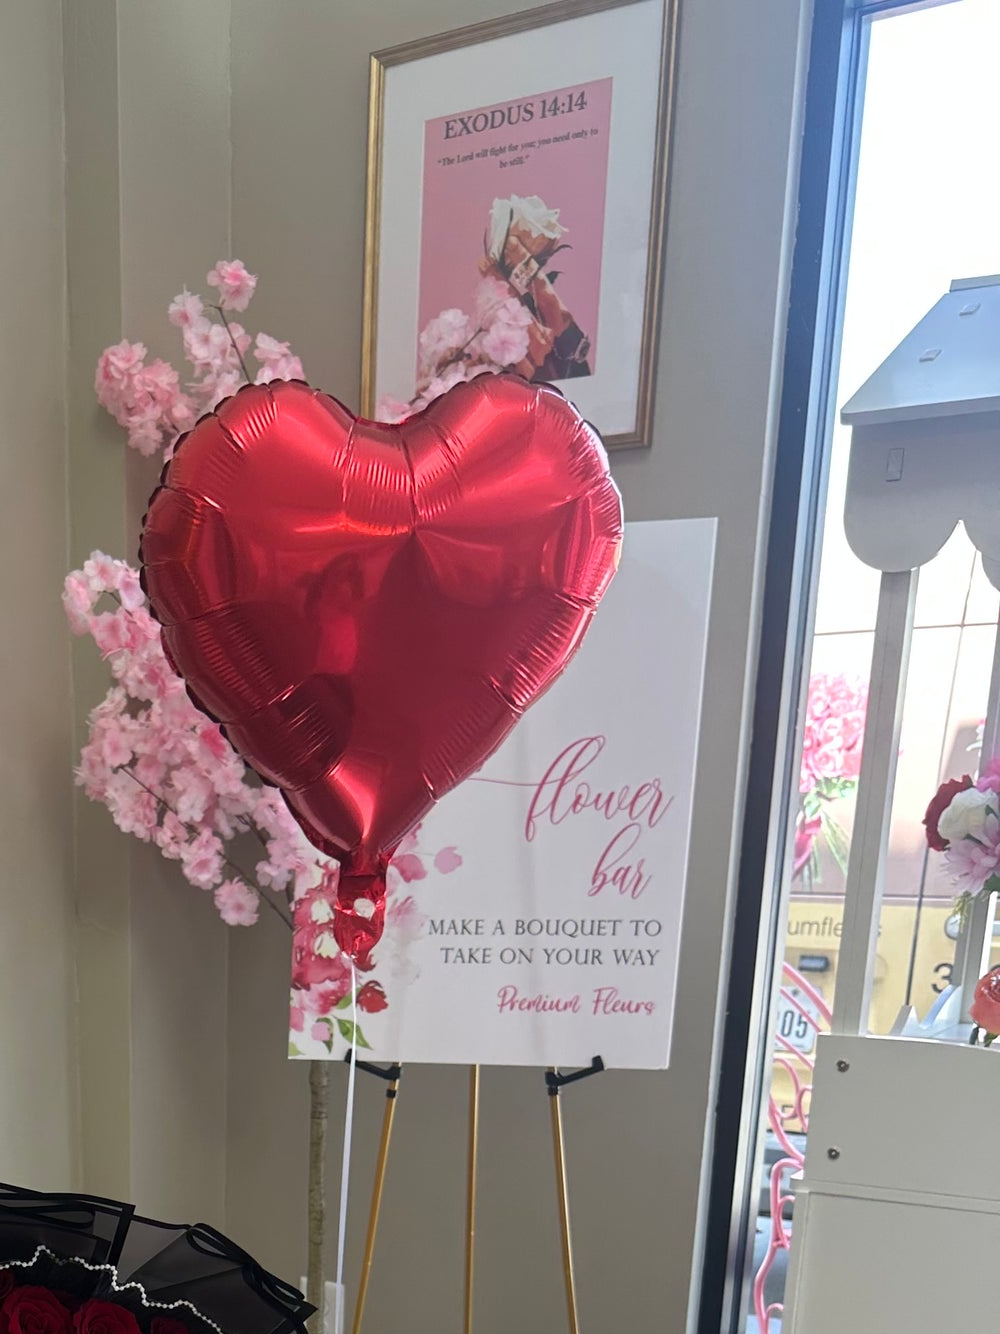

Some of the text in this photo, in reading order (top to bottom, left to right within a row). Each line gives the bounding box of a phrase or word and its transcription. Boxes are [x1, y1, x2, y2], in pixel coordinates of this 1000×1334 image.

[444, 91, 587, 140] EXODUS 14:14
[457, 154, 474, 163] Lord
[475, 149, 488, 159] will
[489, 146, 507, 158] fight
[507, 143, 519, 152] for
[536, 137, 551, 149] you
[552, 132, 570, 144] need
[571, 129, 588, 141] only
[590, 127, 599, 136] to
[499, 158, 508, 169] be
[470, 734, 674, 842] flower
[587, 823, 654, 899] bar
[428, 919, 662, 938] MAKE A BOUQUET TO
[787, 916, 843, 938] umfle
[440, 947, 660, 966] TAKE ON YOUR WAY
[497, 985, 655, 1016] Premium Fleurs
[781, 1010, 808, 1039] 05
